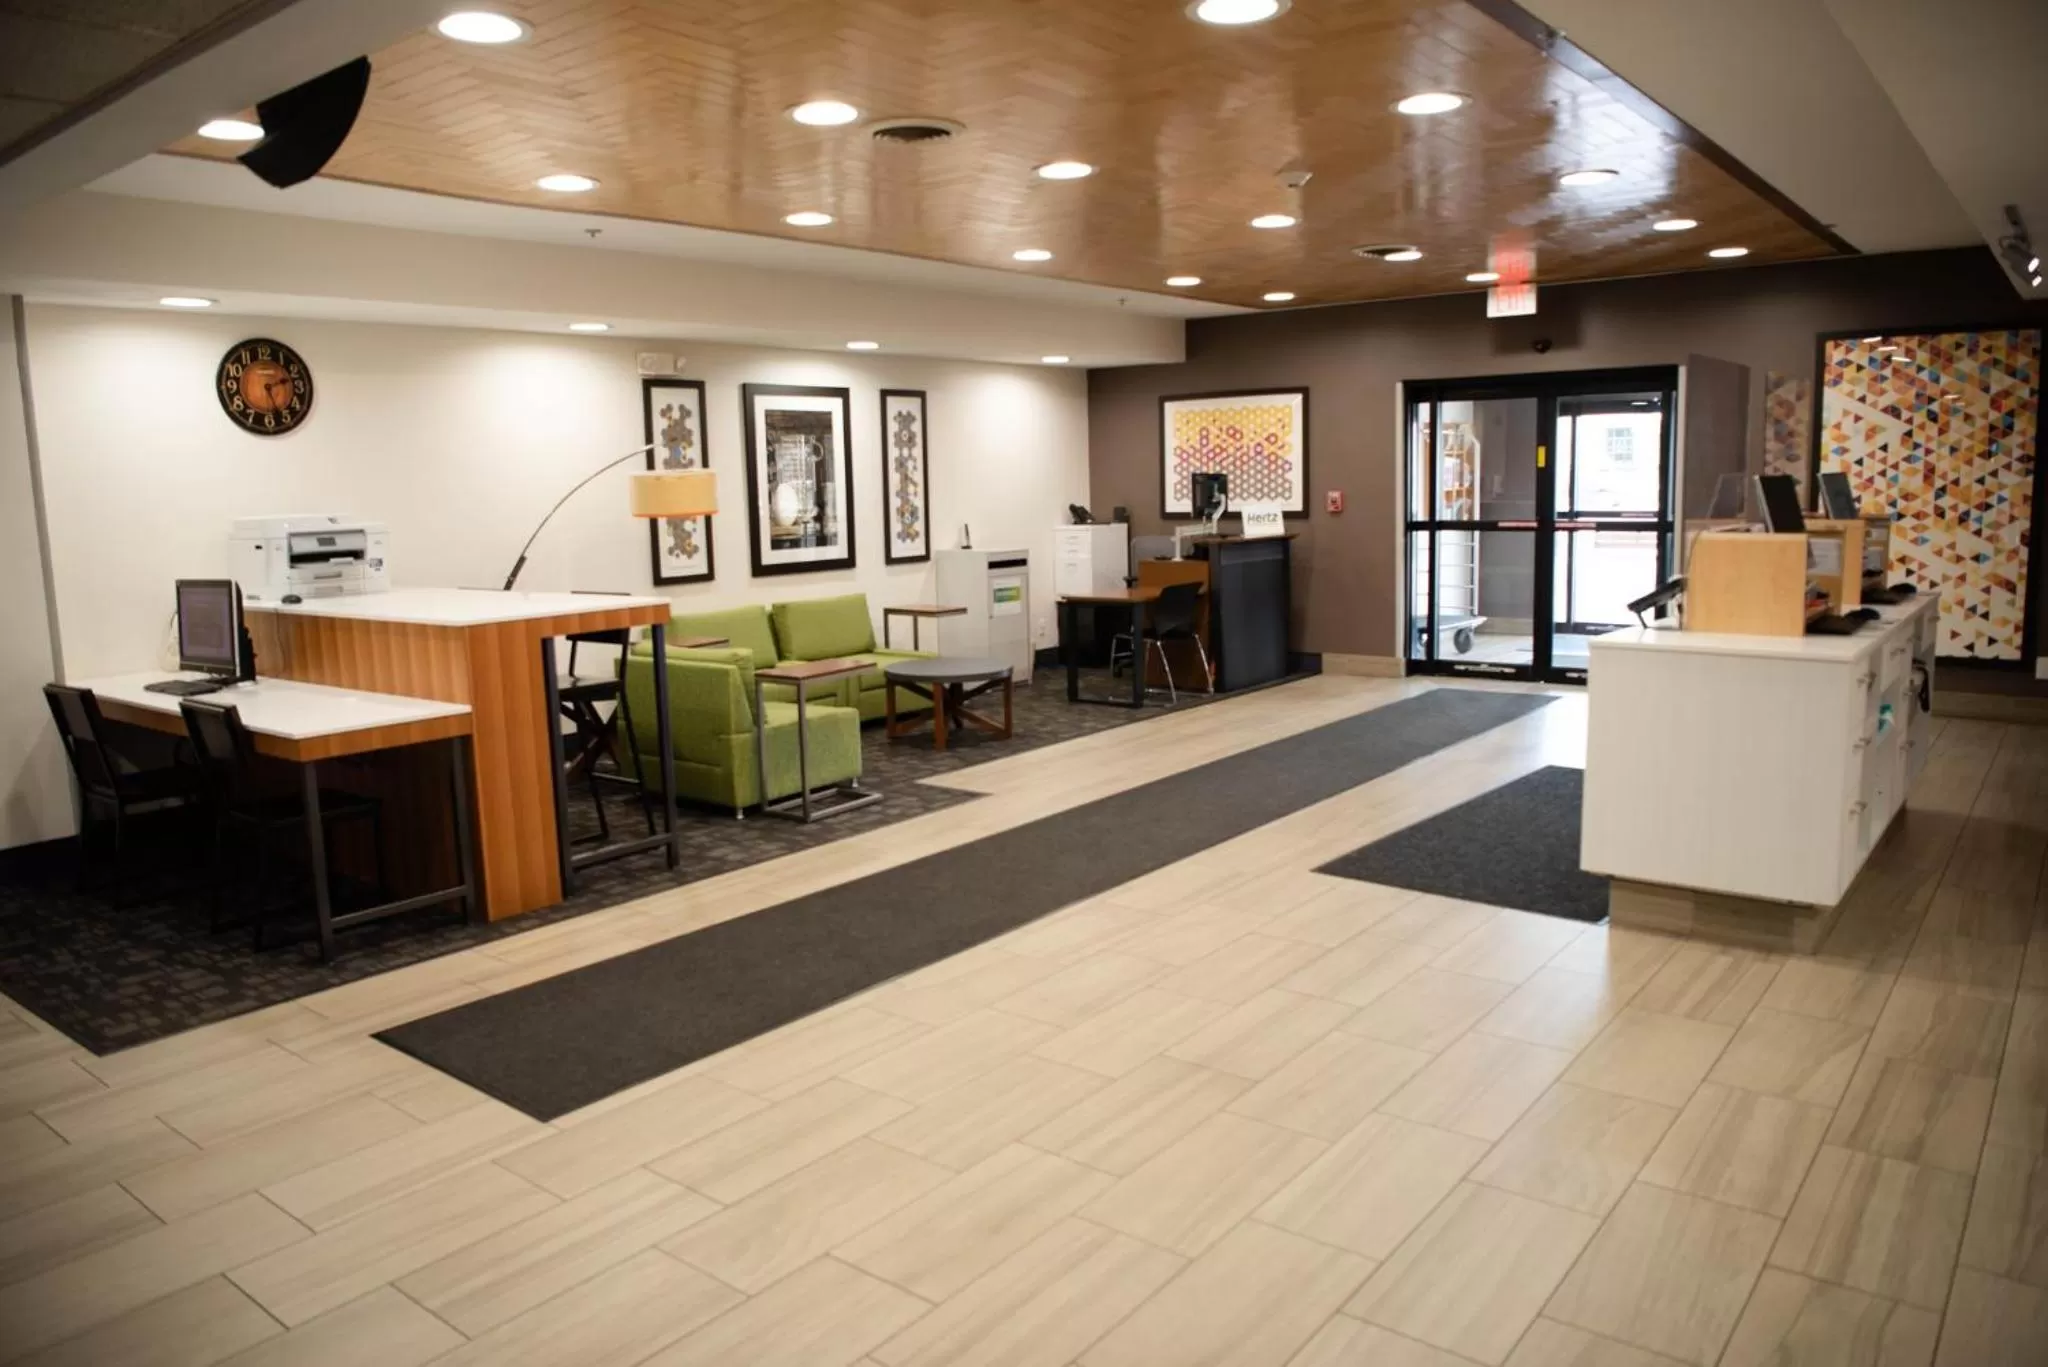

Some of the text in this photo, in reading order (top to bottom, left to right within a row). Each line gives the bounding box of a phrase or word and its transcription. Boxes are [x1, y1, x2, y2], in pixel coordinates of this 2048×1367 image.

[242, 350, 250, 365] 11
[258, 346, 271, 360] 12
[226, 363, 242, 377] 10
[290, 364, 299, 378] 2
[227, 379, 237, 394] 9
[294, 380, 304, 394] 3
[233, 395, 244, 411] 8
[291, 396, 300, 411] 4
[246, 409, 255, 424] 7
[264, 414, 275, 428] 6
[282, 409, 291, 423] 5
[1247, 511, 1279, 524] Hertz
